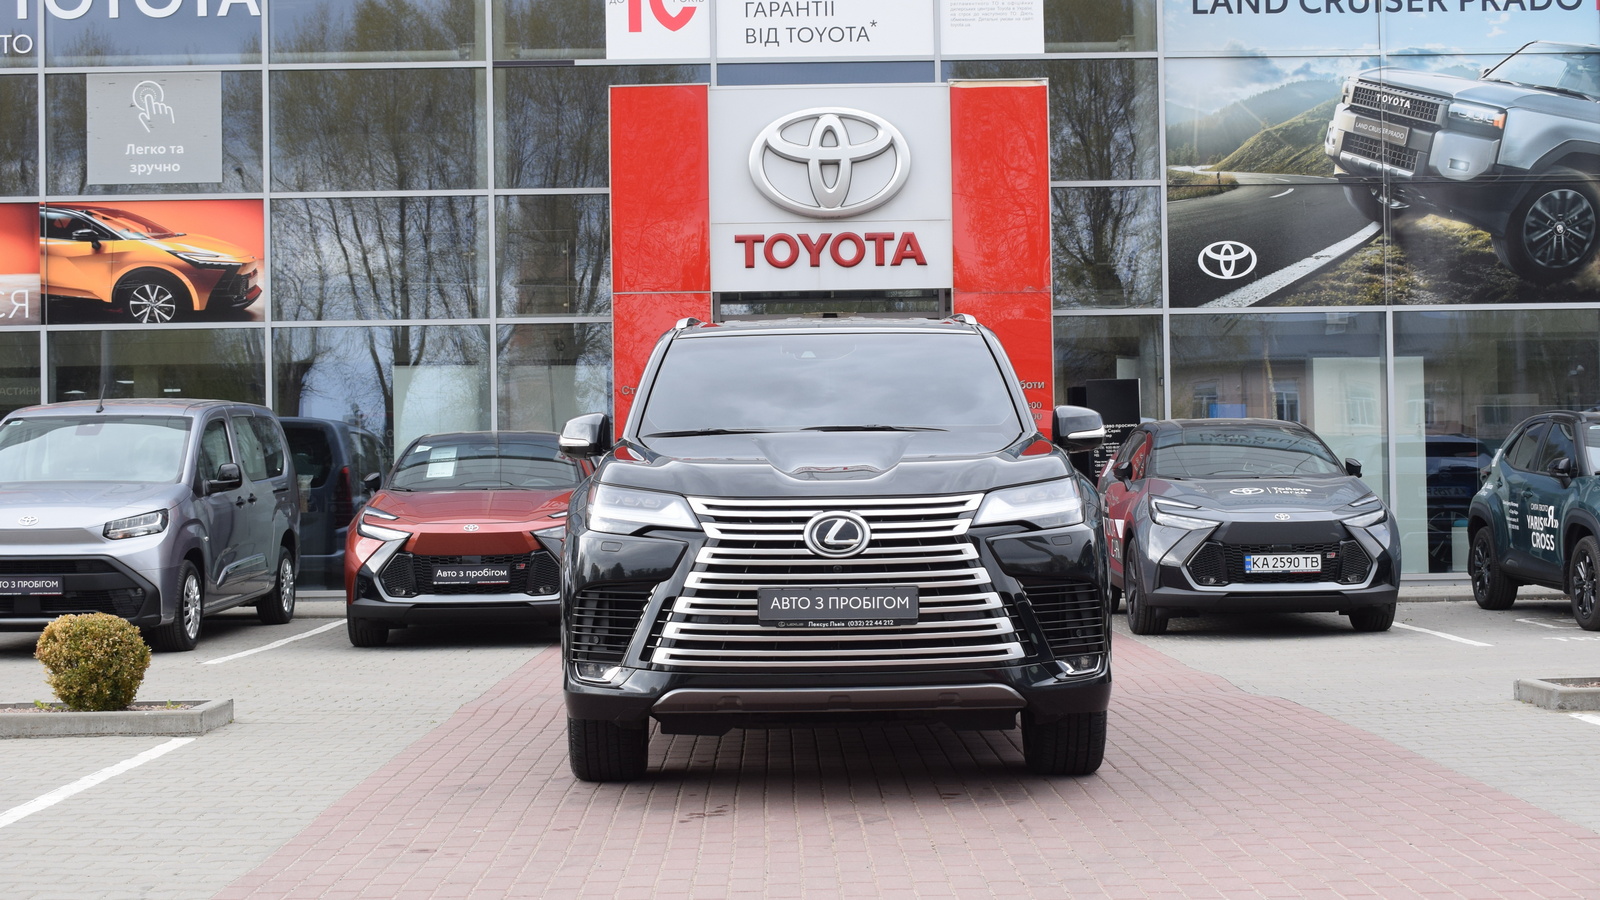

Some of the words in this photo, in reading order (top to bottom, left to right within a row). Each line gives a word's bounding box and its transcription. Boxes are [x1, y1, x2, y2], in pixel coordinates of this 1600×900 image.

[745, 27, 780, 48] ВІД
[1376, 93, 1411, 109] TOYOTA
[1355, 121, 1368, 130] LAND
[1388, 129, 1405, 140] PRADO
[125, 143, 166, 156] Легко
[168, 144, 185, 155] та
[129, 160, 181, 176] зручно
[734, 231, 928, 270] TOYOTA
[1526, 514, 1544, 531] YARIS
[1531, 531, 1555, 551] CROSS
[1252, 557, 1270, 569] KA
[1272, 556, 1300, 569] 2590
[1302, 556, 1320, 568] TB
[436, 569, 457, 578] Авто
[466, 568, 507, 579] пробігом
[10, 580, 16, 589] З
[17, 580, 59, 588] ПРОБІГОМ
[770, 596, 811, 610] АВТО
[815, 596, 824, 609] З
[828, 595, 909, 610] ПРОБІГОМ
